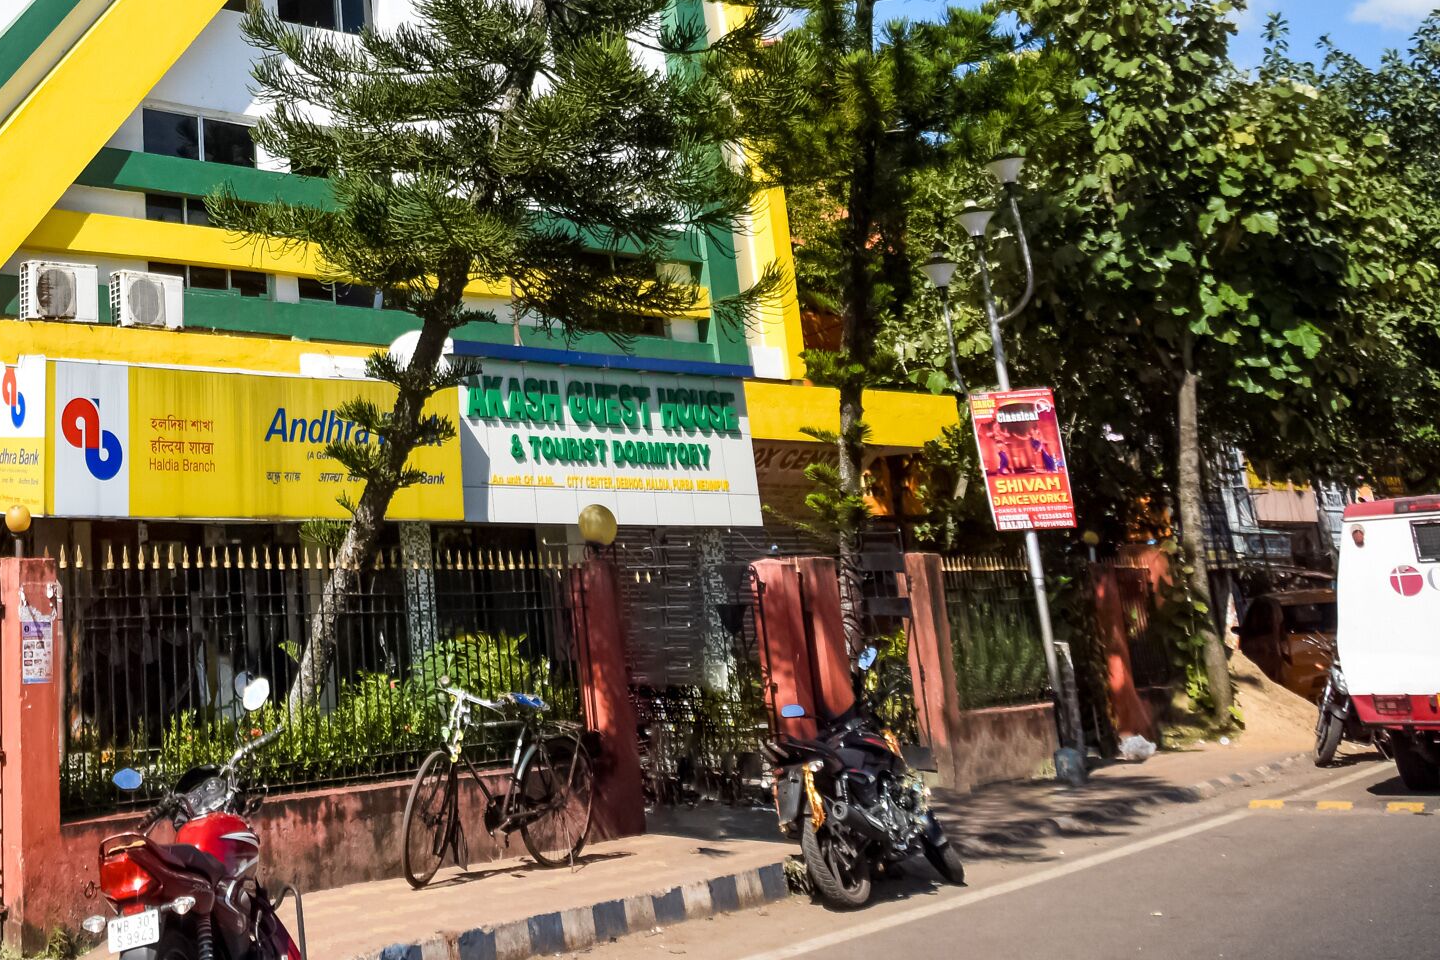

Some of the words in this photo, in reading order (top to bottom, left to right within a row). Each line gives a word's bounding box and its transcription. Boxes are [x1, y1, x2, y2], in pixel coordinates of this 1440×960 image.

[466, 375, 561, 422] AKASH
[566, 380, 651, 428] GUEST
[656, 386, 740, 432] HOUSE
[996, 410, 1040, 423] Classical
[19, 447, 39, 466] Bank
[510, 433, 526, 464] &
[529, 435, 607, 466] TOURIST
[612, 438, 711, 469] DORMITORY
[149, 458, 179, 471] Haldia
[182, 458, 216, 473] Branch
[420, 471, 445, 485] Bank
[566, 475, 584, 488] CITY
[995, 477, 1061, 493] SHIVAM
[994, 492, 1069, 506] DANCEWORKZ
